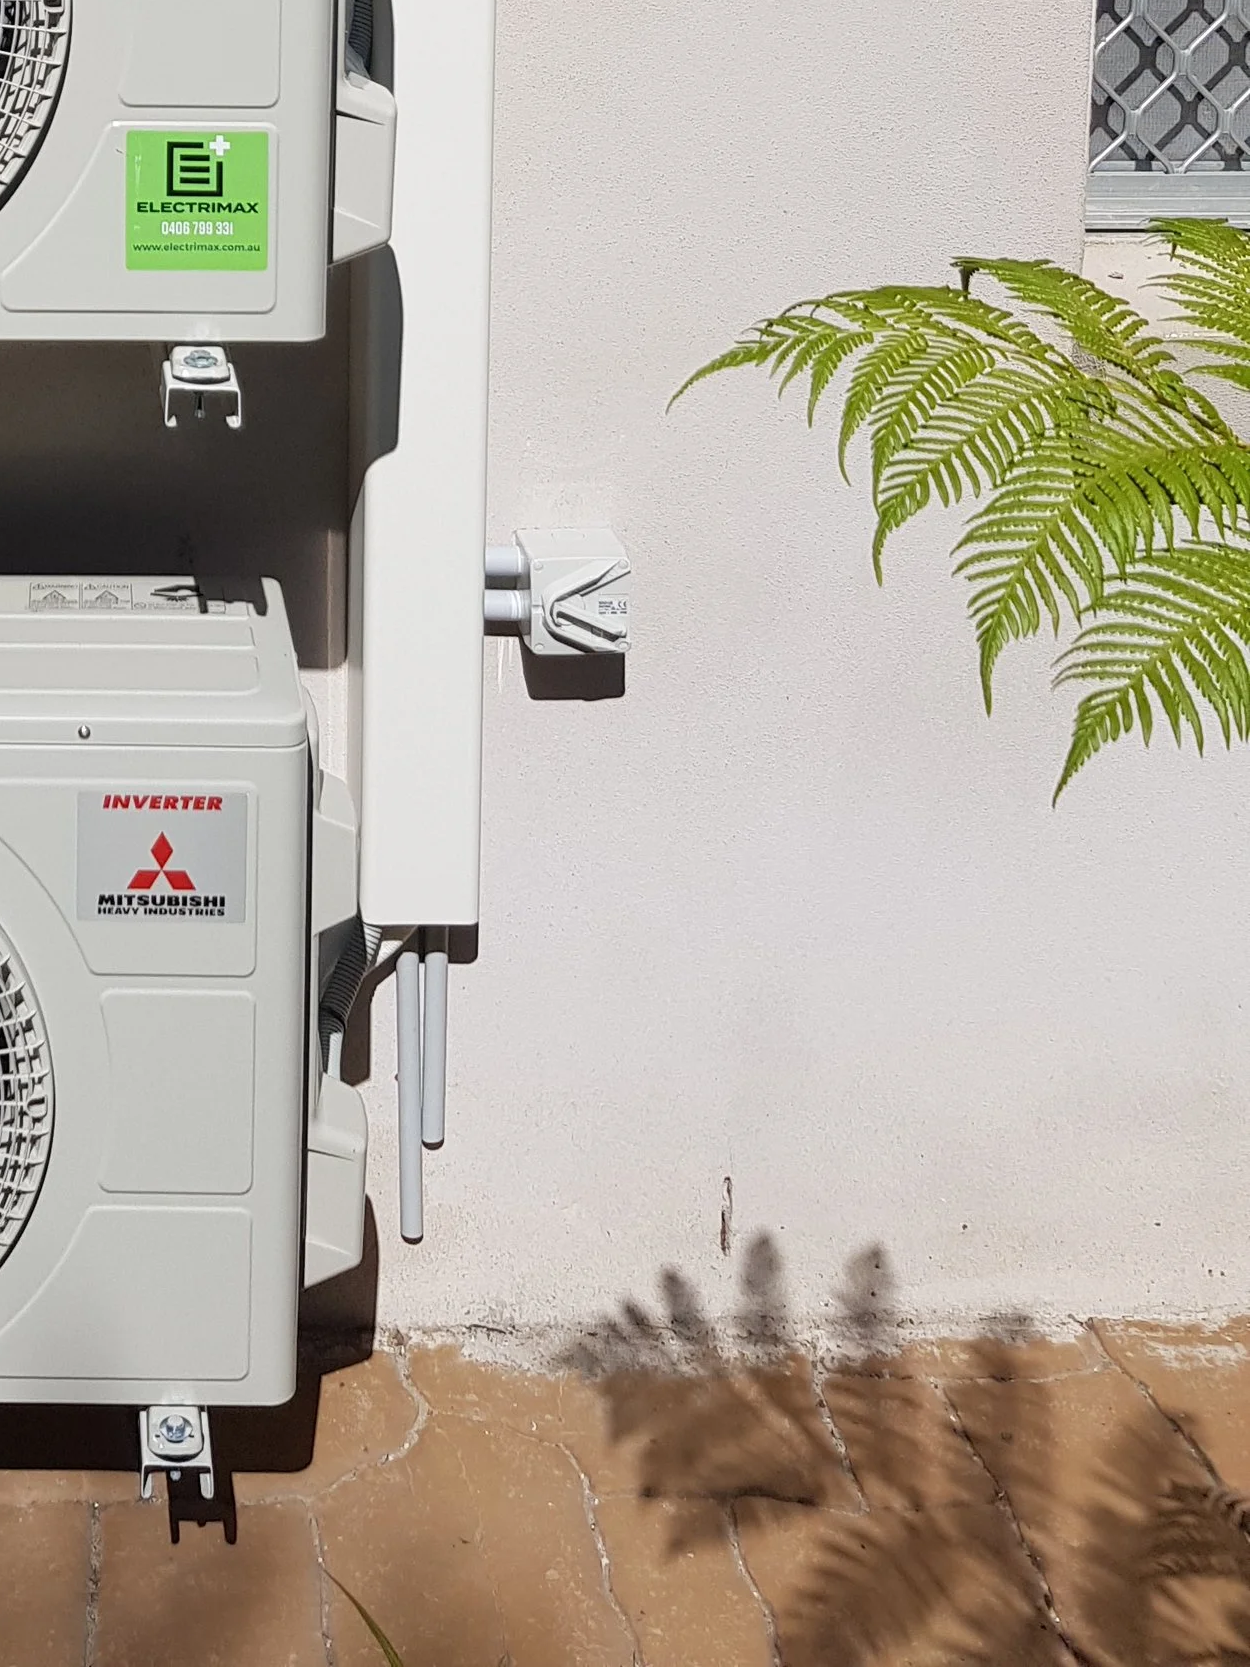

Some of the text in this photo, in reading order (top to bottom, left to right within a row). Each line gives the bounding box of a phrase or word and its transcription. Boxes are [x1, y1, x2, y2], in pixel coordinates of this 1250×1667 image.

[136, 201, 259, 214] ELECTRIMAX
[161, 221, 190, 235] 0406
[215, 221, 234, 235] 331
[132, 242, 261, 252] www.electrimax.com.au
[102, 794, 223, 811] INVERTER
[97, 894, 226, 907] MITSUBISHI
[97, 907, 225, 917] HEAVY INDUSTRIES
